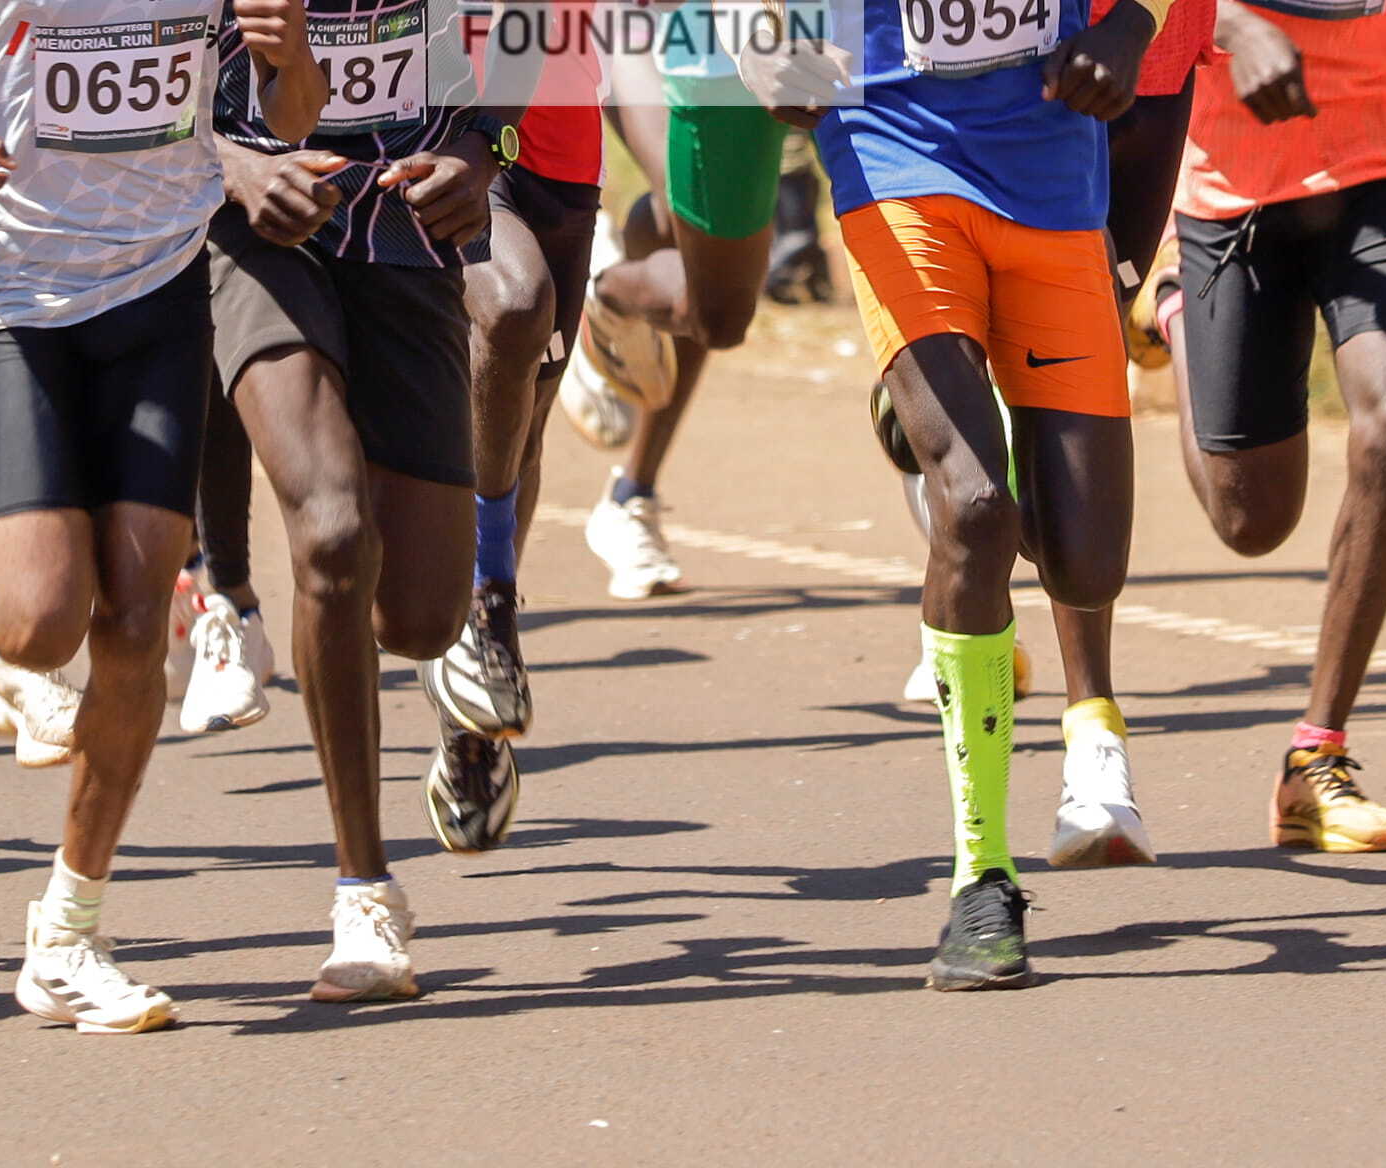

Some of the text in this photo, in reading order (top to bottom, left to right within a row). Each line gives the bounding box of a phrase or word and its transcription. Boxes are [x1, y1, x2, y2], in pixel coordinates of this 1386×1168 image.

[57, 26, 102, 36] REBECCA
[102, 23, 153, 34] CHEPTEGEI
[317, 22, 368, 32] CHEPTEGEI
[377, 16, 420, 34] mzzo
[36, 34, 153, 50] MEMORIAL RUN
[335, 33, 368, 45] RUN
[45, 51, 192, 116] 0655
[317, 48, 414, 107] 487
